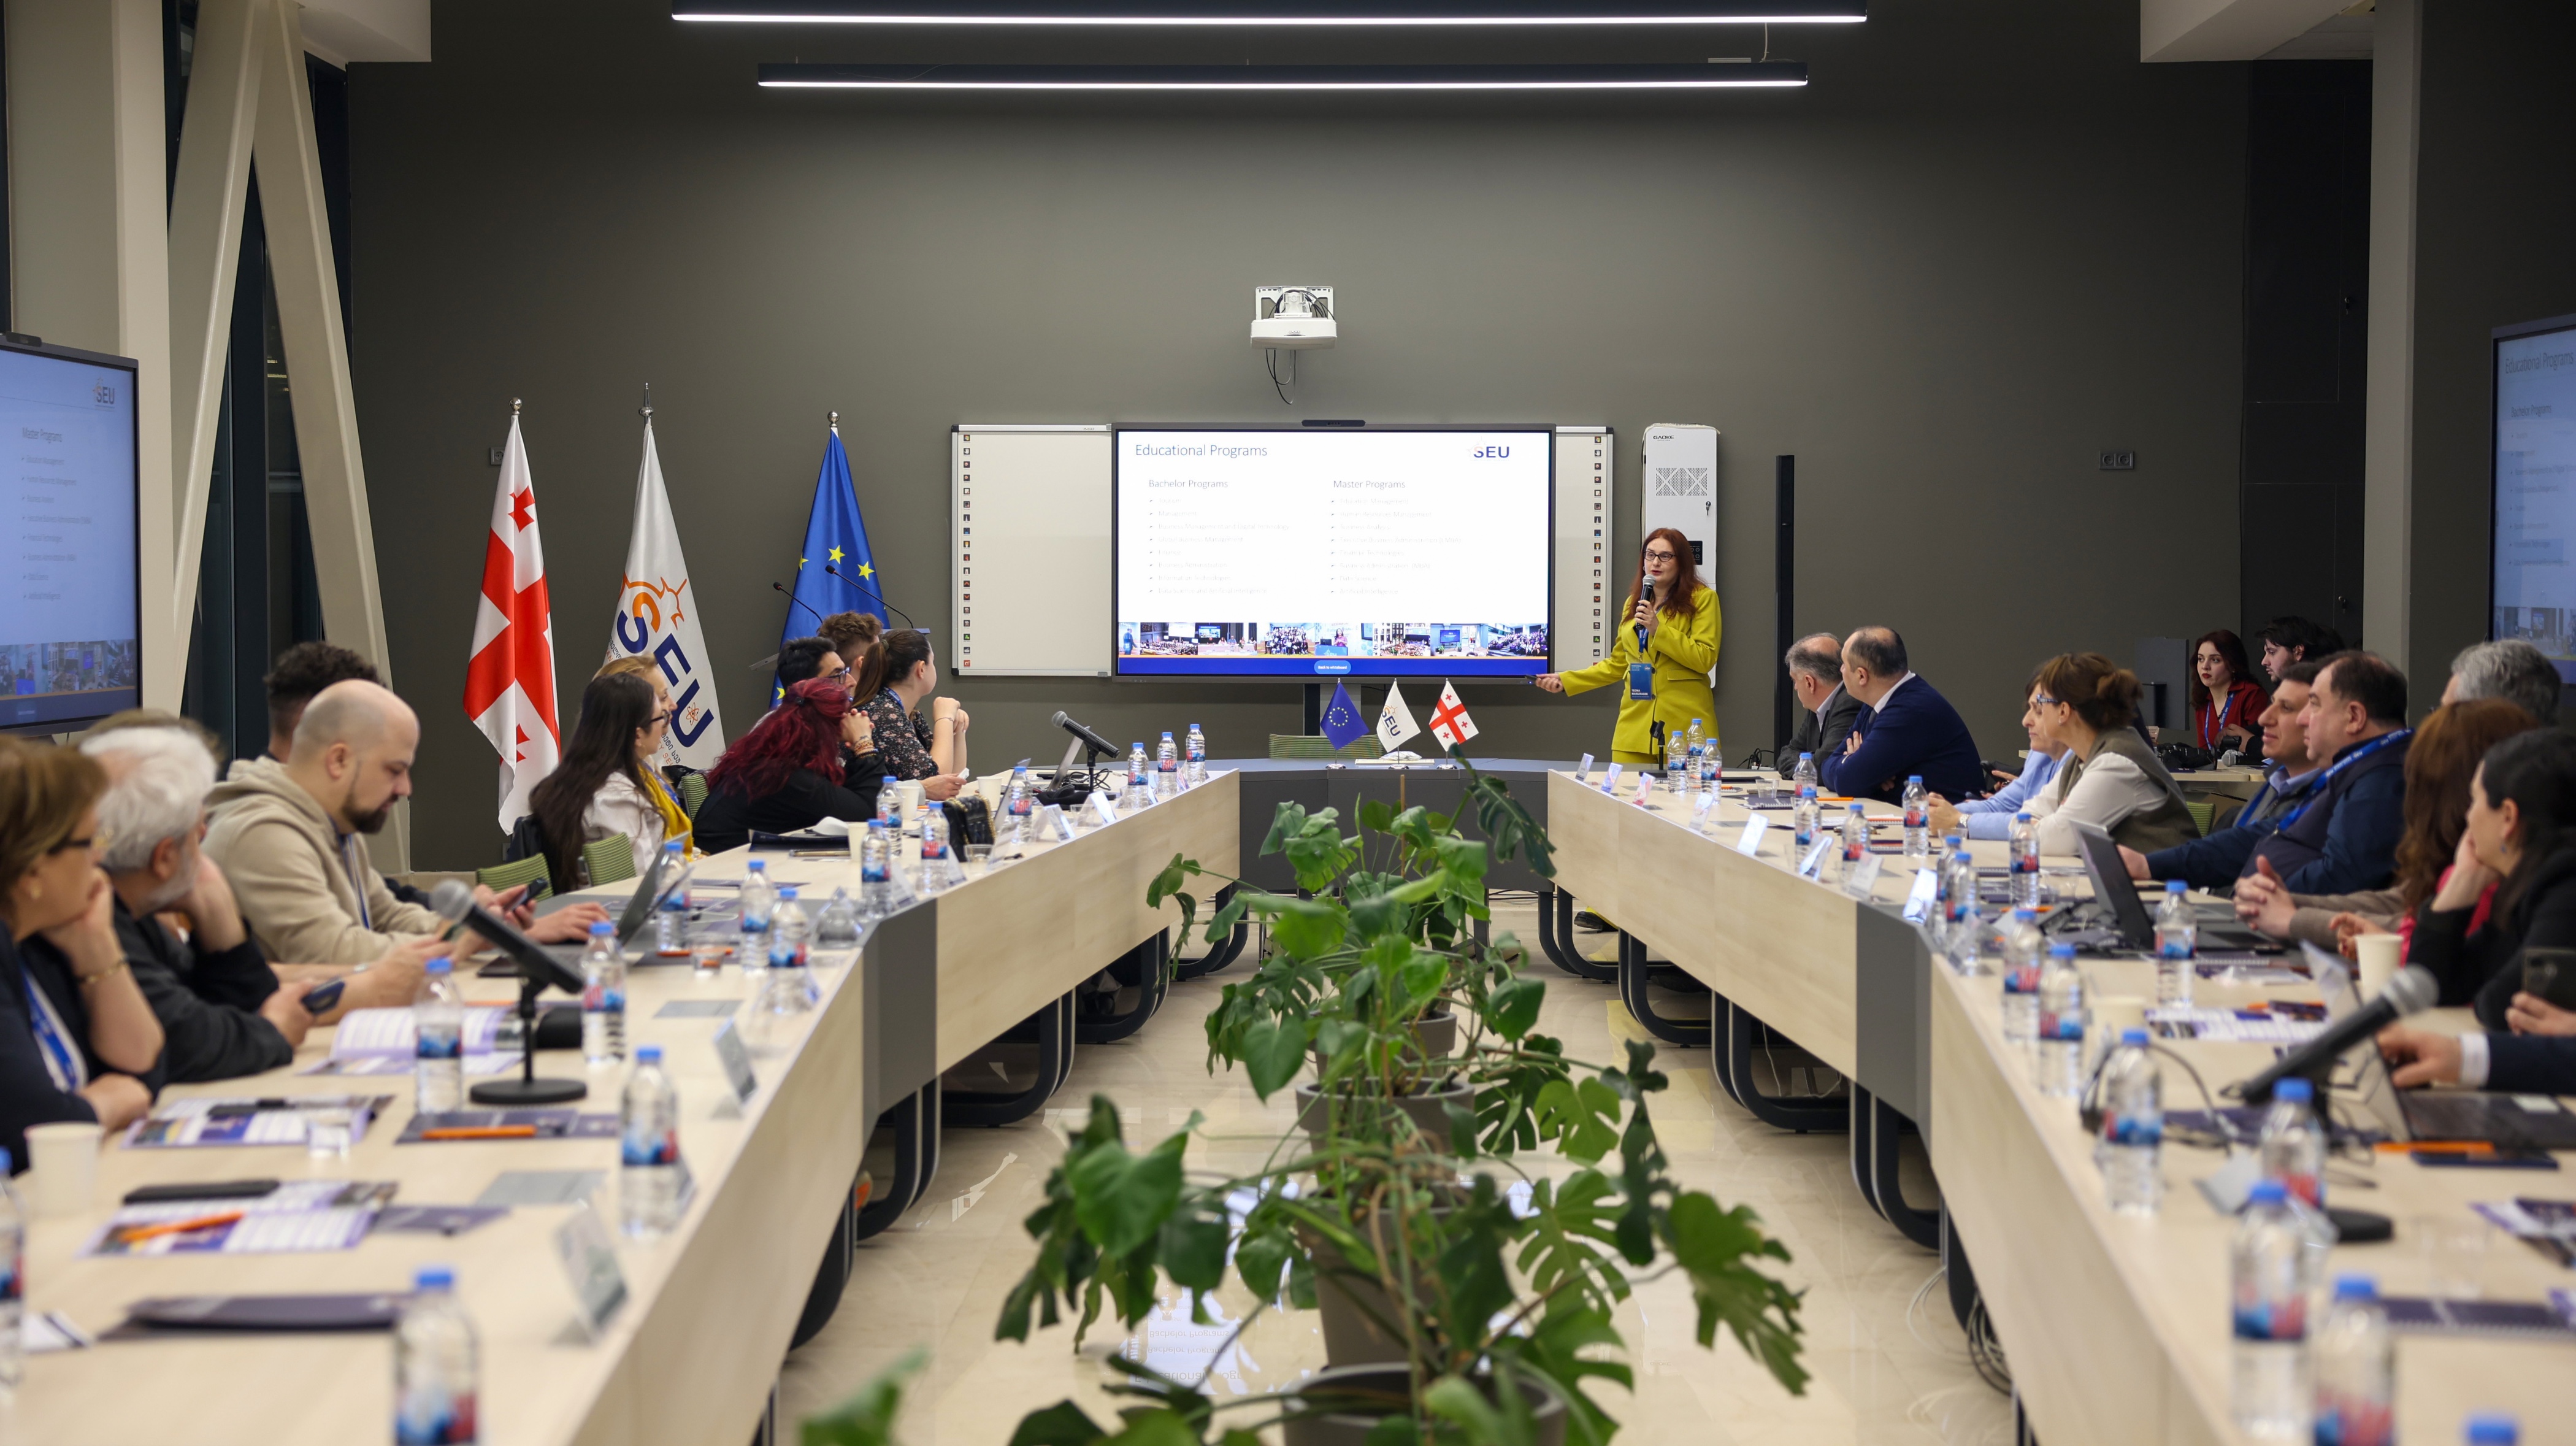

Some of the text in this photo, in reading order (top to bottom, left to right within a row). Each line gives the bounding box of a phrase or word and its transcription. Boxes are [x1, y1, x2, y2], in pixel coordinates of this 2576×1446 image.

[2543, 352, 2574, 371] Programs
[96, 385, 115, 404] SEU
[1135, 444, 1267, 459] Educational Programs
[1473, 446, 1510, 458] SEU
[1189, 480, 1229, 489] Programs
[1365, 480, 1406, 490] Programs
[617, 592, 715, 748] SEU
[1382, 707, 1401, 737] SEU
